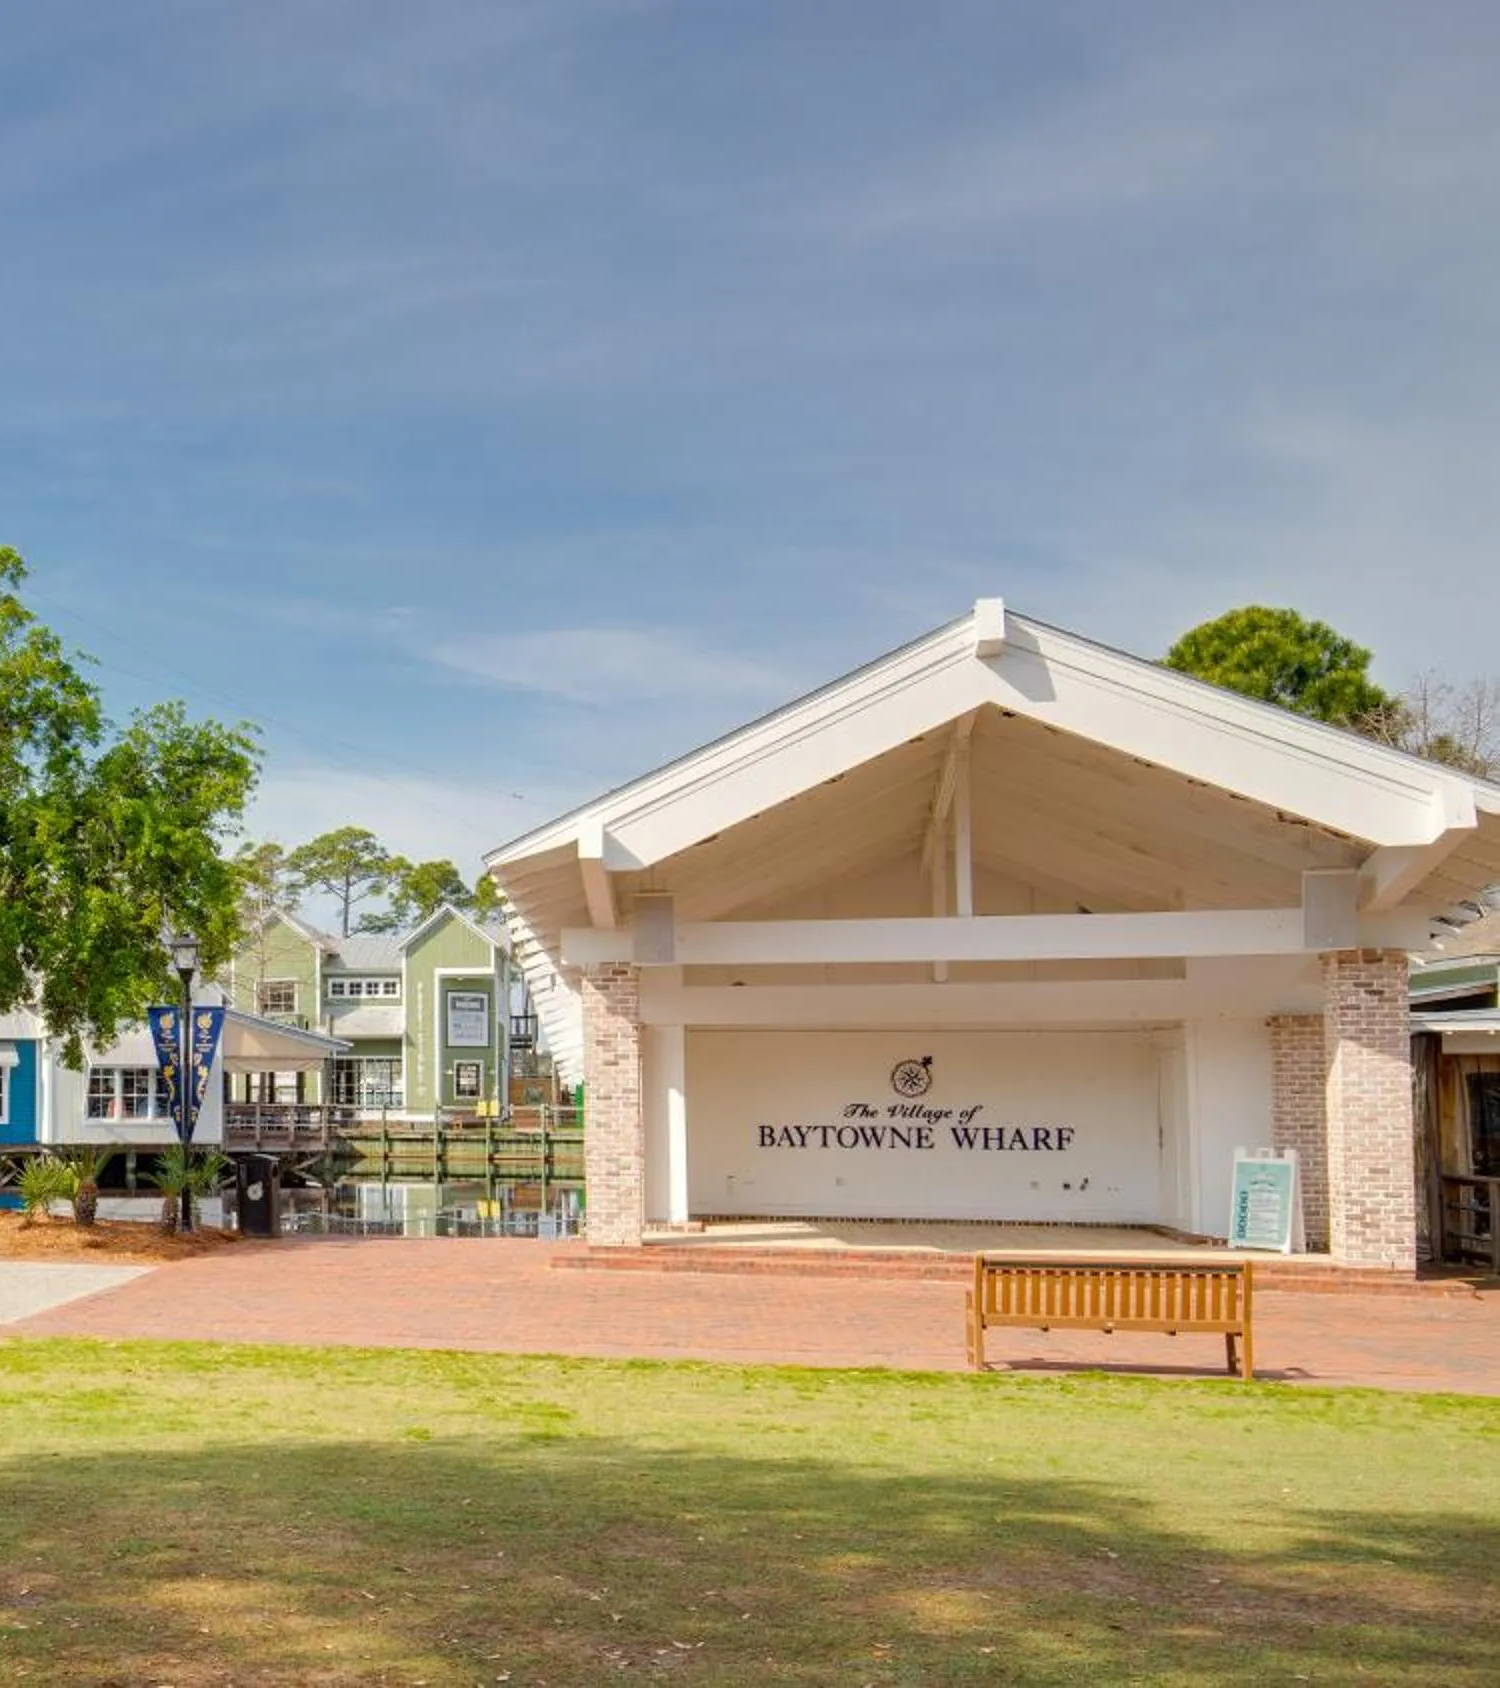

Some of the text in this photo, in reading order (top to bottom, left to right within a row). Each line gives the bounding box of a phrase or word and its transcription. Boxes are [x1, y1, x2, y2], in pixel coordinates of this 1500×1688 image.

[844, 1103, 984, 1125] The Village of
[757, 1125, 1075, 1150] BAYTOWNE WHARF
